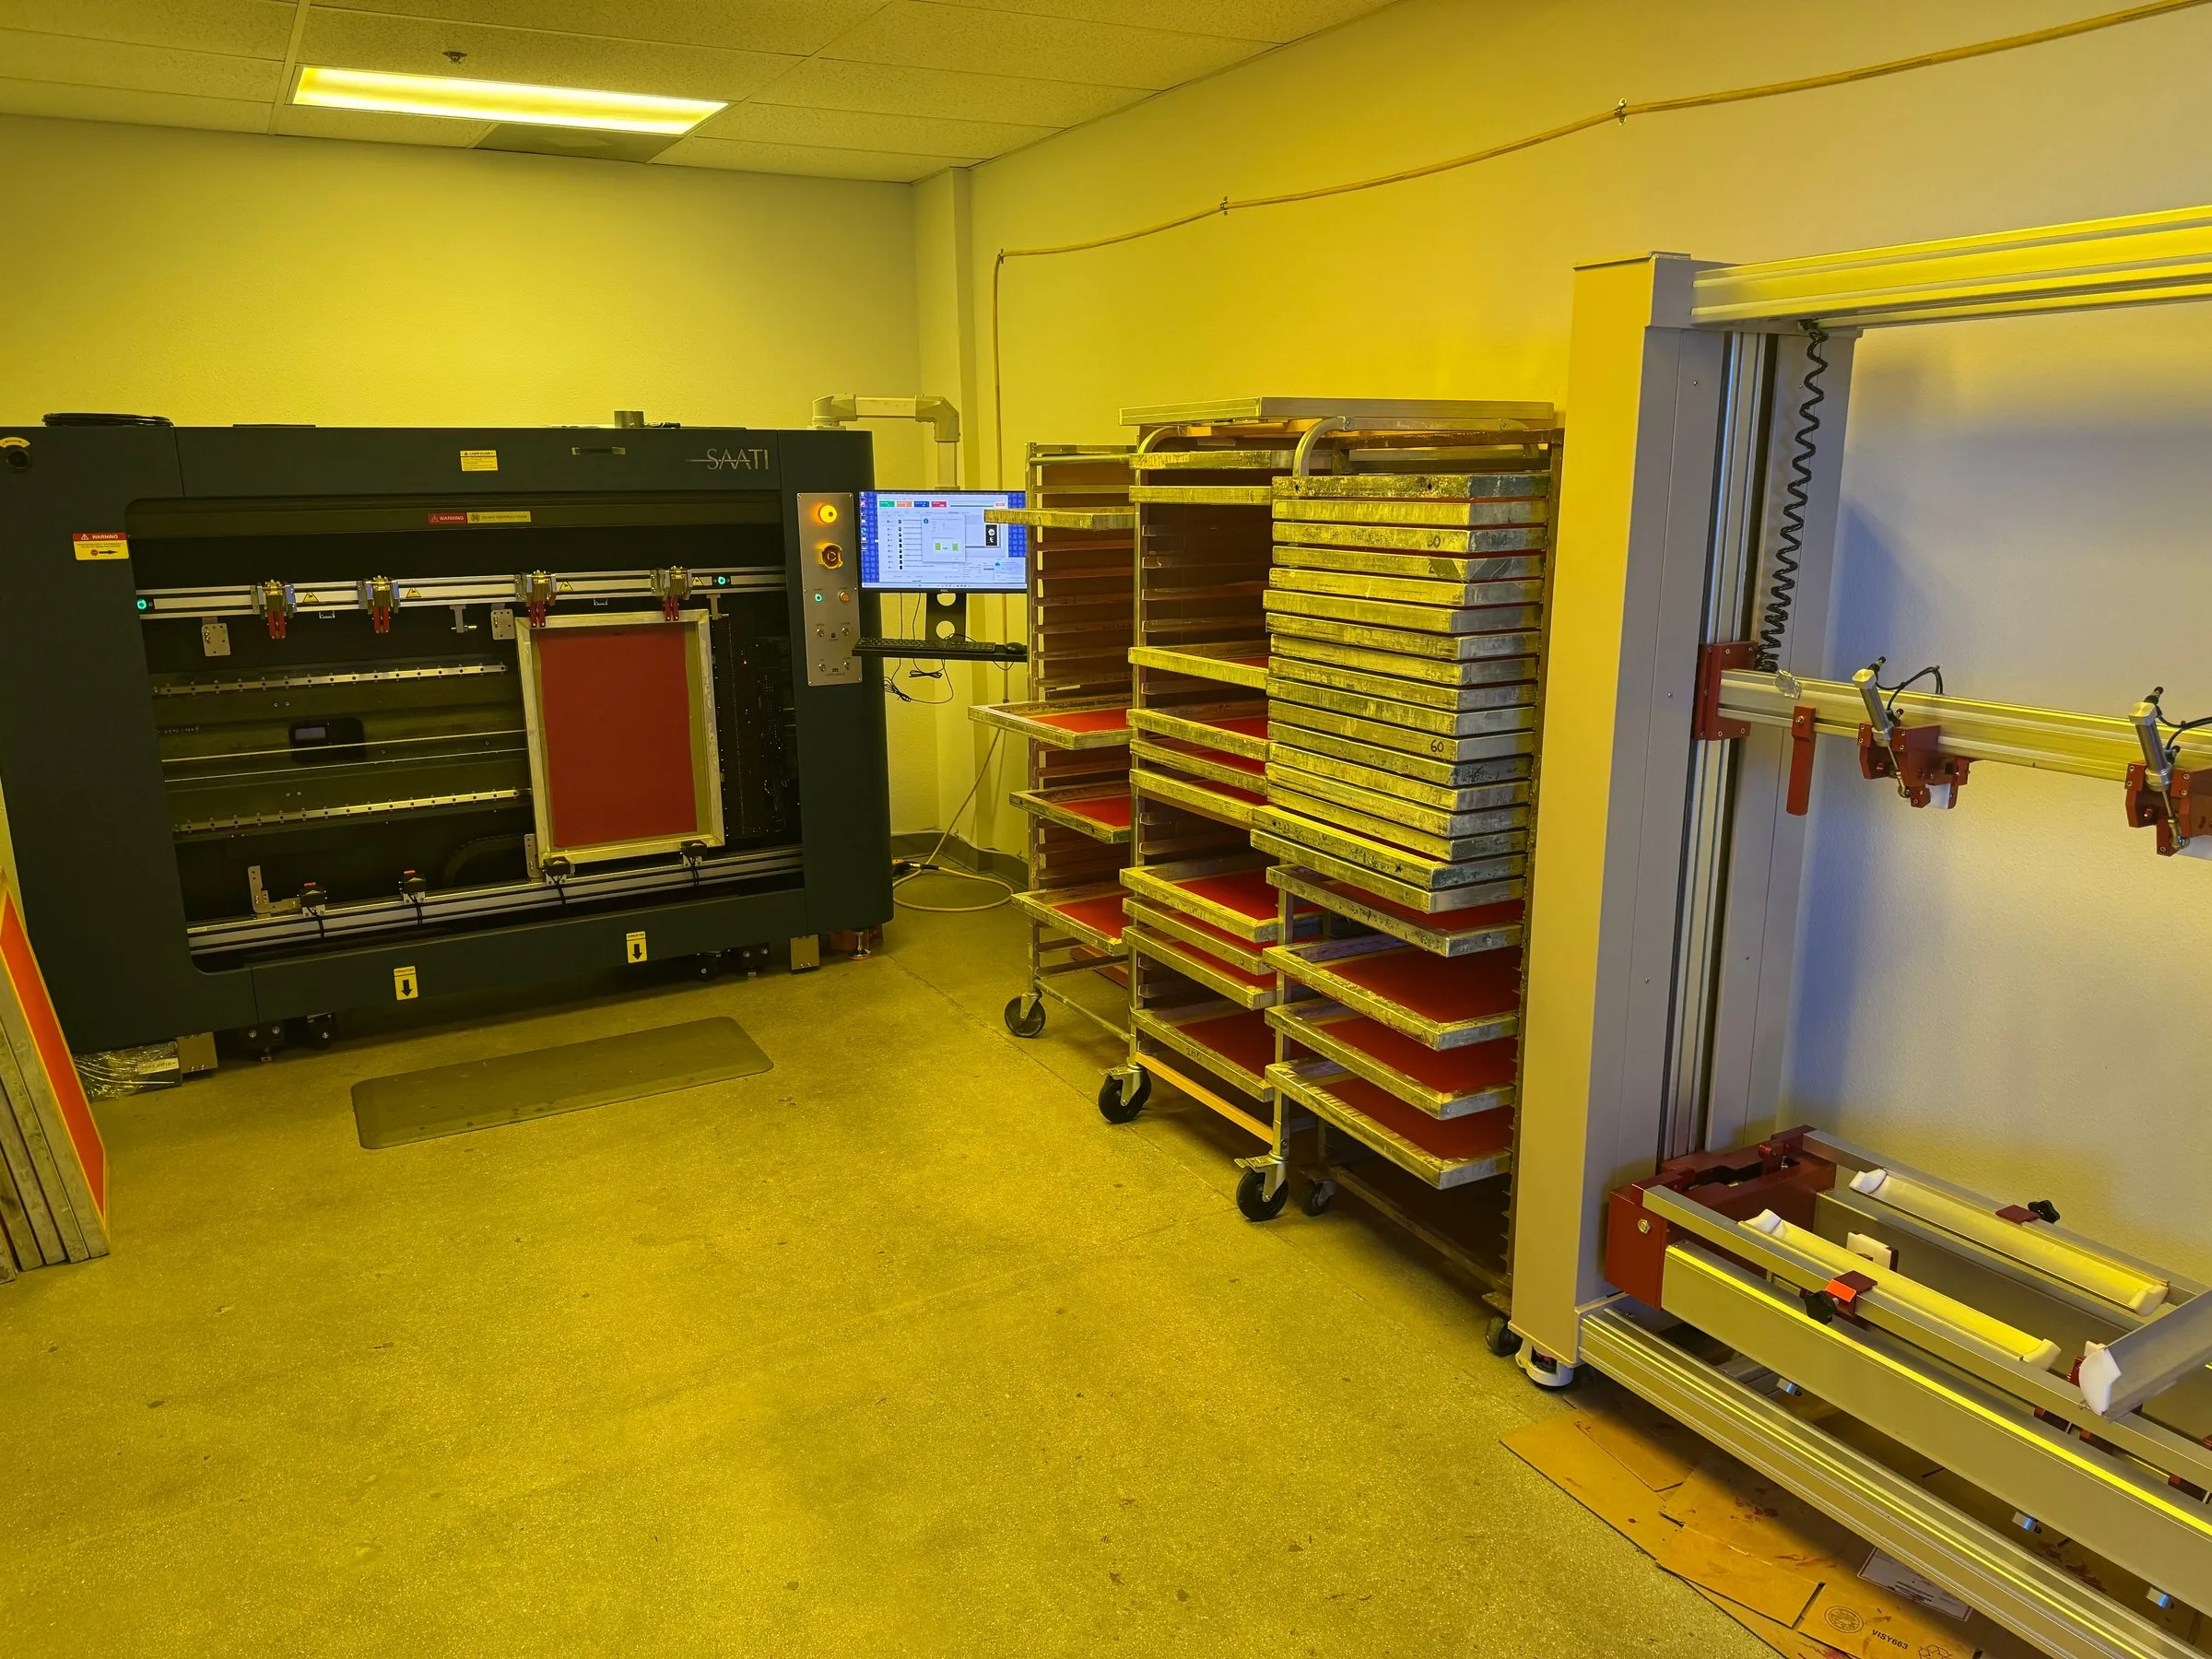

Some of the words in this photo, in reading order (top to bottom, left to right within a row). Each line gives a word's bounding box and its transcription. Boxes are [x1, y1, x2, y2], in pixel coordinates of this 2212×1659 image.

[706, 448, 770, 470] SAATI
[1430, 738, 1444, 753] 60
[1872, 1630, 1909, 1650] VISY663
